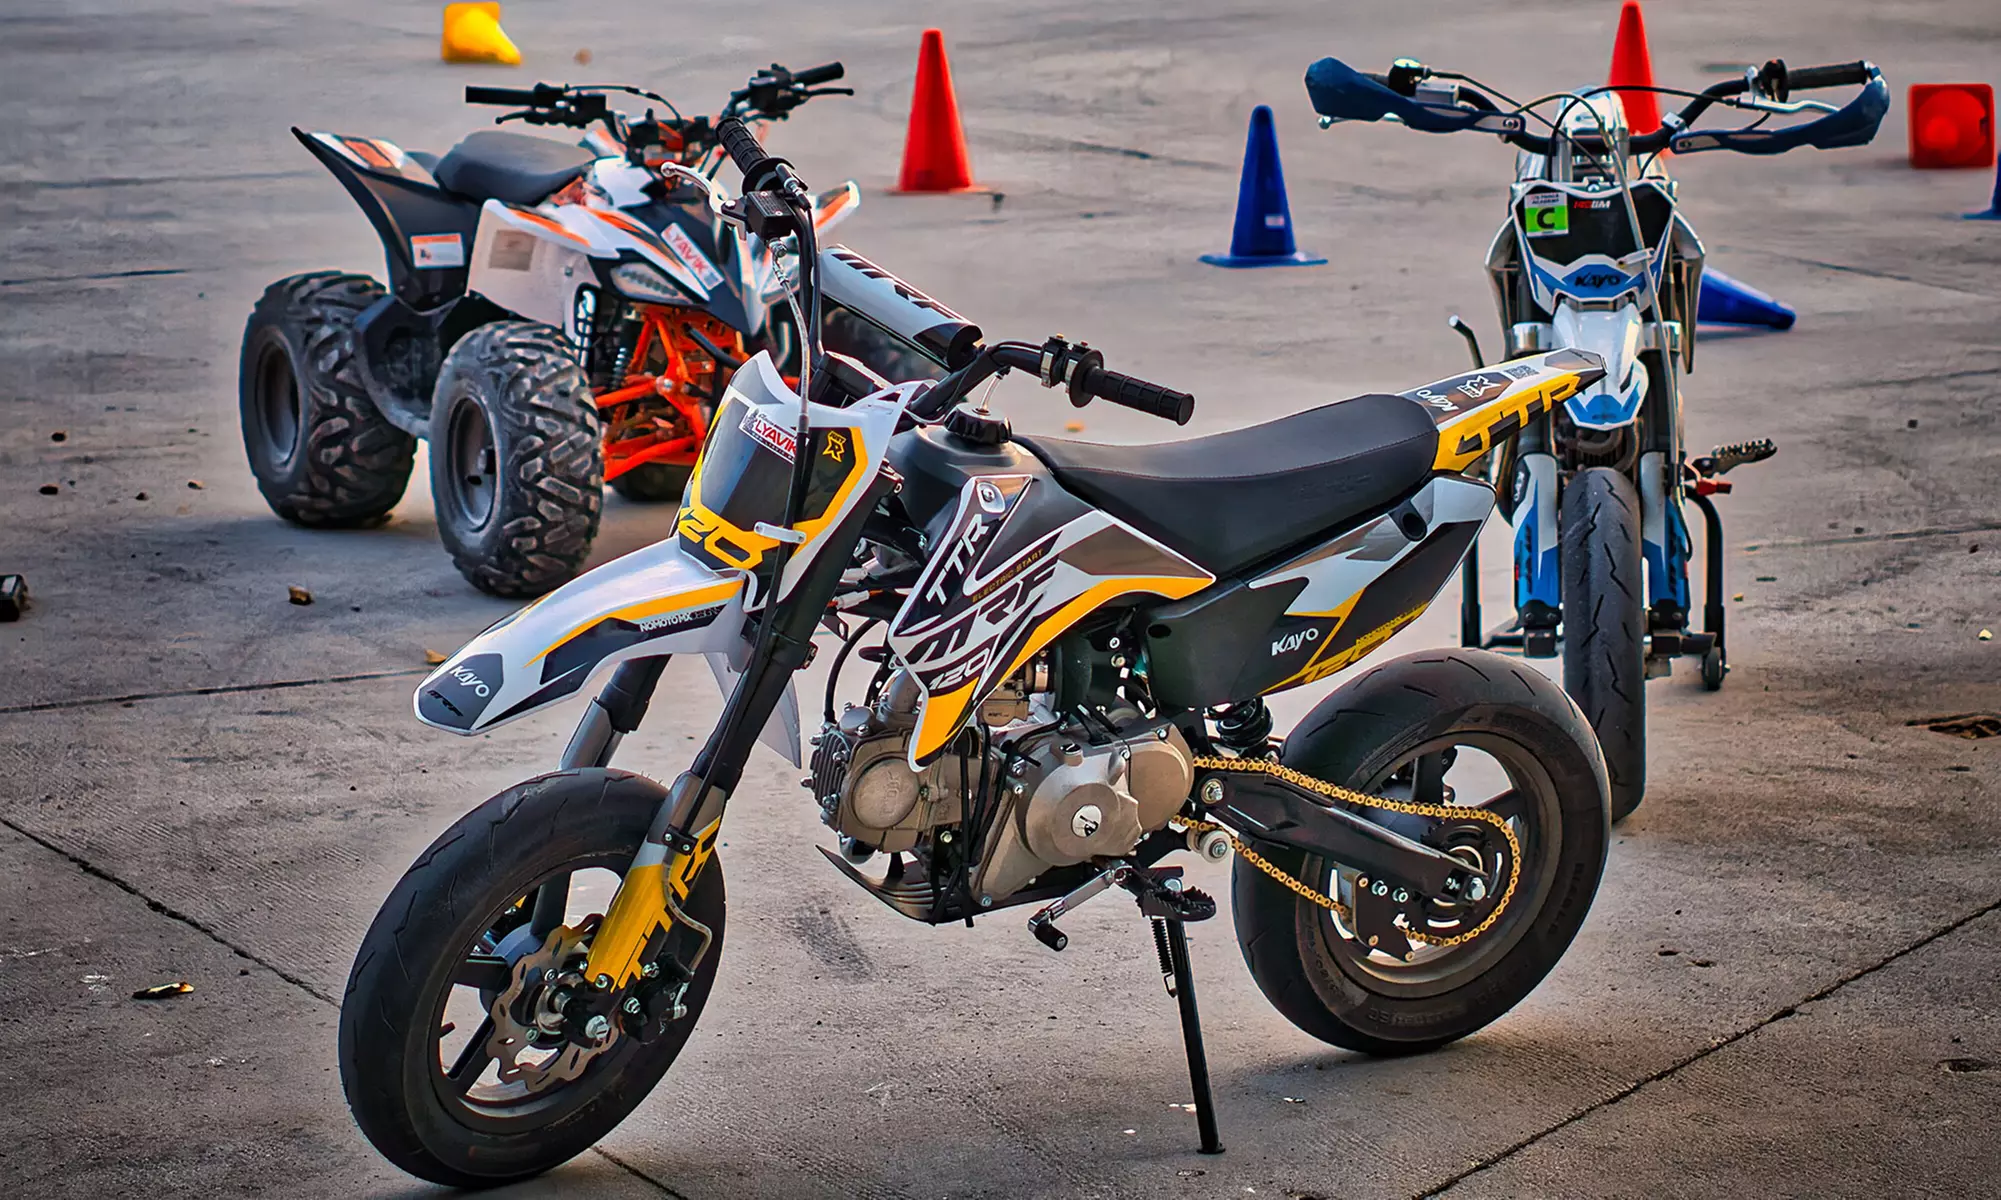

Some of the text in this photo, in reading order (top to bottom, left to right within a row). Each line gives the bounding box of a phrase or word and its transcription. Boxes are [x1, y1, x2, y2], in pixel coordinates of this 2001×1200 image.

[1537, 207, 1555, 229] C
[1574, 273, 1620, 288] KAYO
[1416, 389, 1459, 412] KAYO
[926, 514, 989, 605] TTR
[972, 548, 1044, 603] ELECTRIC START
[1271, 628, 1319, 656] KAYO
[449, 665, 490, 697] KAYO
[929, 648, 990, 690] 120
